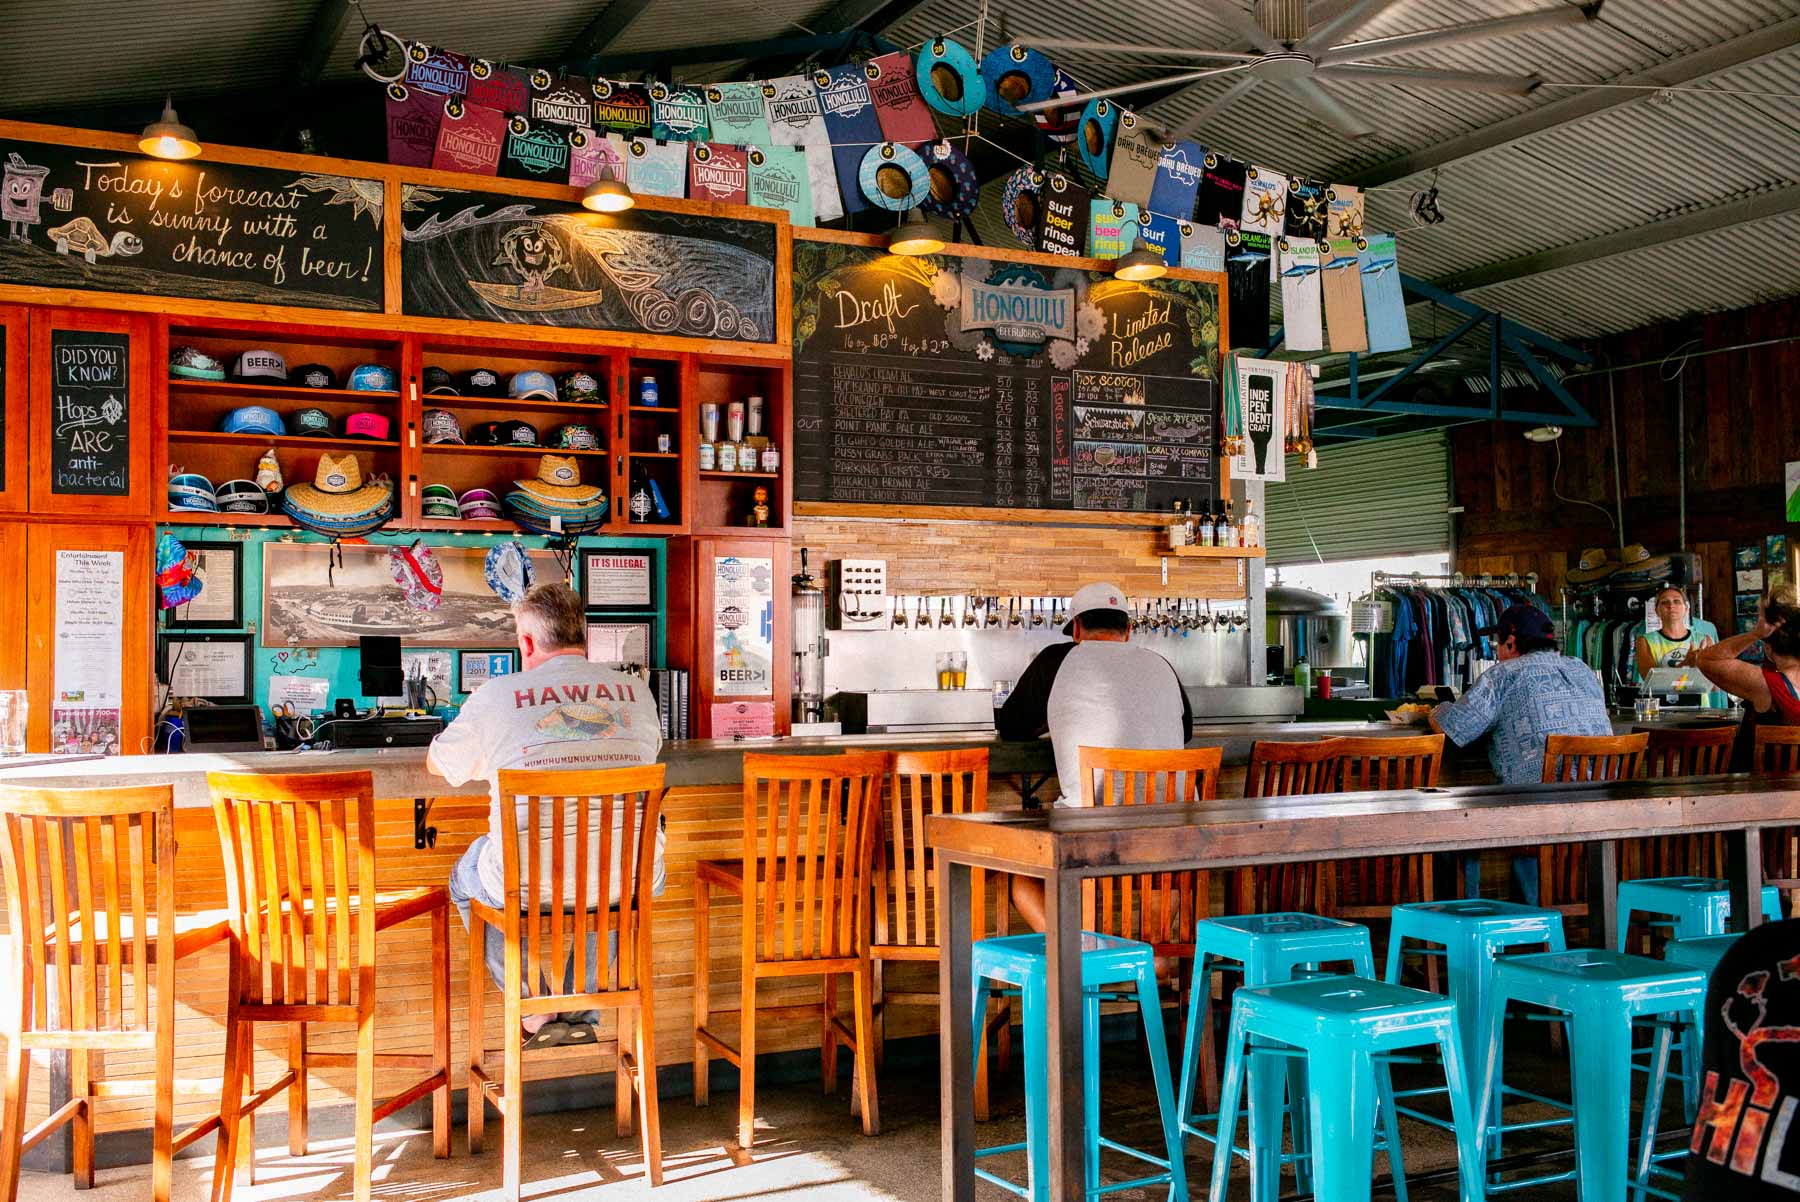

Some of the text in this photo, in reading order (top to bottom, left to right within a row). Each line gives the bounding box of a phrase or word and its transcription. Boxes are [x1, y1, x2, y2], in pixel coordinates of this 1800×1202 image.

[412, 50, 425, 59] 19
[411, 64, 464, 90] HONOLULU
[474, 65, 487, 75] 20
[868, 68, 878, 76] 27
[534, 76, 546, 86] 21
[817, 76, 829, 85] 26
[596, 85, 608, 95] 22
[652, 89, 664, 98] 23
[709, 92, 720, 100] 24
[764, 87, 775, 96] 25
[826, 87, 867, 110] HONOLULU
[451, 105, 459, 115] 2
[537, 103, 587, 124] HONOLULU
[599, 107, 646, 123] HONOLULU
[658, 104, 704, 124] HONOLULU
[715, 99, 760, 117] HONOLULU
[774, 100, 818, 119] HONOLULU
[514, 121, 522, 131] 3
[574, 134, 582, 144] 4
[1118, 137, 1136, 151] OAHU
[445, 134, 495, 162] HONOLULU
[513, 142, 563, 163] HONOLULU
[634, 144, 642, 153] 5
[699, 150, 706, 158] 6
[753, 154, 760, 163] 7
[1176, 160, 1202, 178] BREWED
[699, 169, 741, 187] HONOLULU
[1054, 179, 1063, 188] 11
[75, 161, 309, 215] Today's forecast
[754, 178, 797, 198] HONOLULU
[1048, 200, 1073, 217] surf
[107, 202, 328, 245] is sunny with a
[1046, 211, 1073, 231] beer
[1044, 225, 1075, 245] rinse
[1095, 225, 1121, 237] beer
[1142, 227, 1166, 243] surf
[172, 242, 372, 284] chance of beer!
[834, 280, 919, 333] Draft
[973, 288, 1065, 329] HONOLULU
[1113, 299, 1173, 339] Limited
[999, 322, 1042, 340] BEERWORKS
[901, 337, 908, 351] 4
[1111, 331, 1173, 369] Release
[61, 348, 117, 365] DID YOU
[68, 366, 118, 382] KNOW?
[1249, 388, 1270, 402] INDE
[56, 395, 97, 428] Hops
[1249, 400, 1267, 413] PEN
[835, 419, 861, 431] POINT
[1249, 412, 1272, 425] DENT
[1249, 424, 1270, 433] CRAFT
[834, 447, 862, 459] PUSSY
[68, 455, 104, 470] anti-
[834, 460, 880, 475] PARKING
[881, 463, 922, 477] TICKETS
[926, 465, 950, 478] RED
[58, 465, 125, 489] bacterial
[75, 559, 90, 567] This
[592, 558, 646, 569] IT IS ILLEGAL:
[718, 613, 747, 624] HONOLULU
[514, 683, 636, 708] HAWAII
